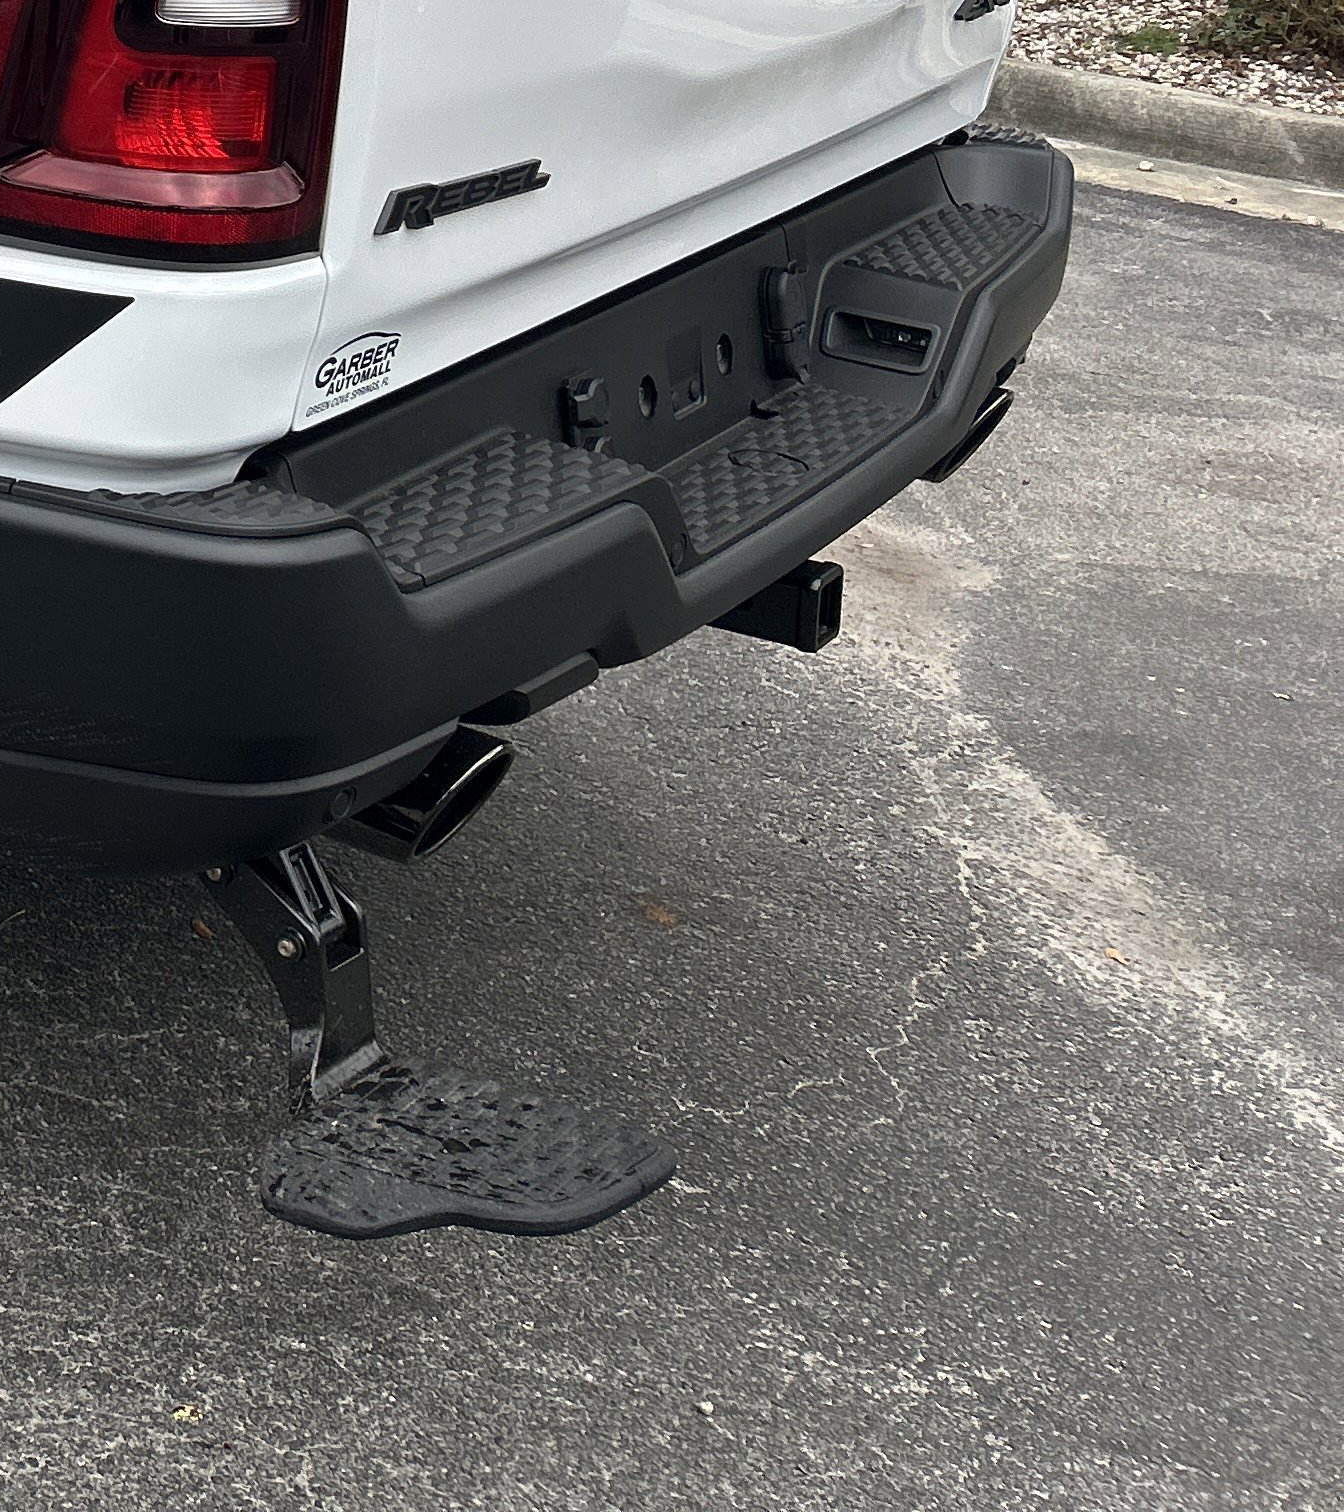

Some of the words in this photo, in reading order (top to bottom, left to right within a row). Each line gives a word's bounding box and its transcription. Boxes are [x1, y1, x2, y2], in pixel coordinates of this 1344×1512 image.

[373, 158, 551, 236] REBEL
[315, 338, 399, 389] GARBER
[325, 360, 391, 397] AUTOMALL
